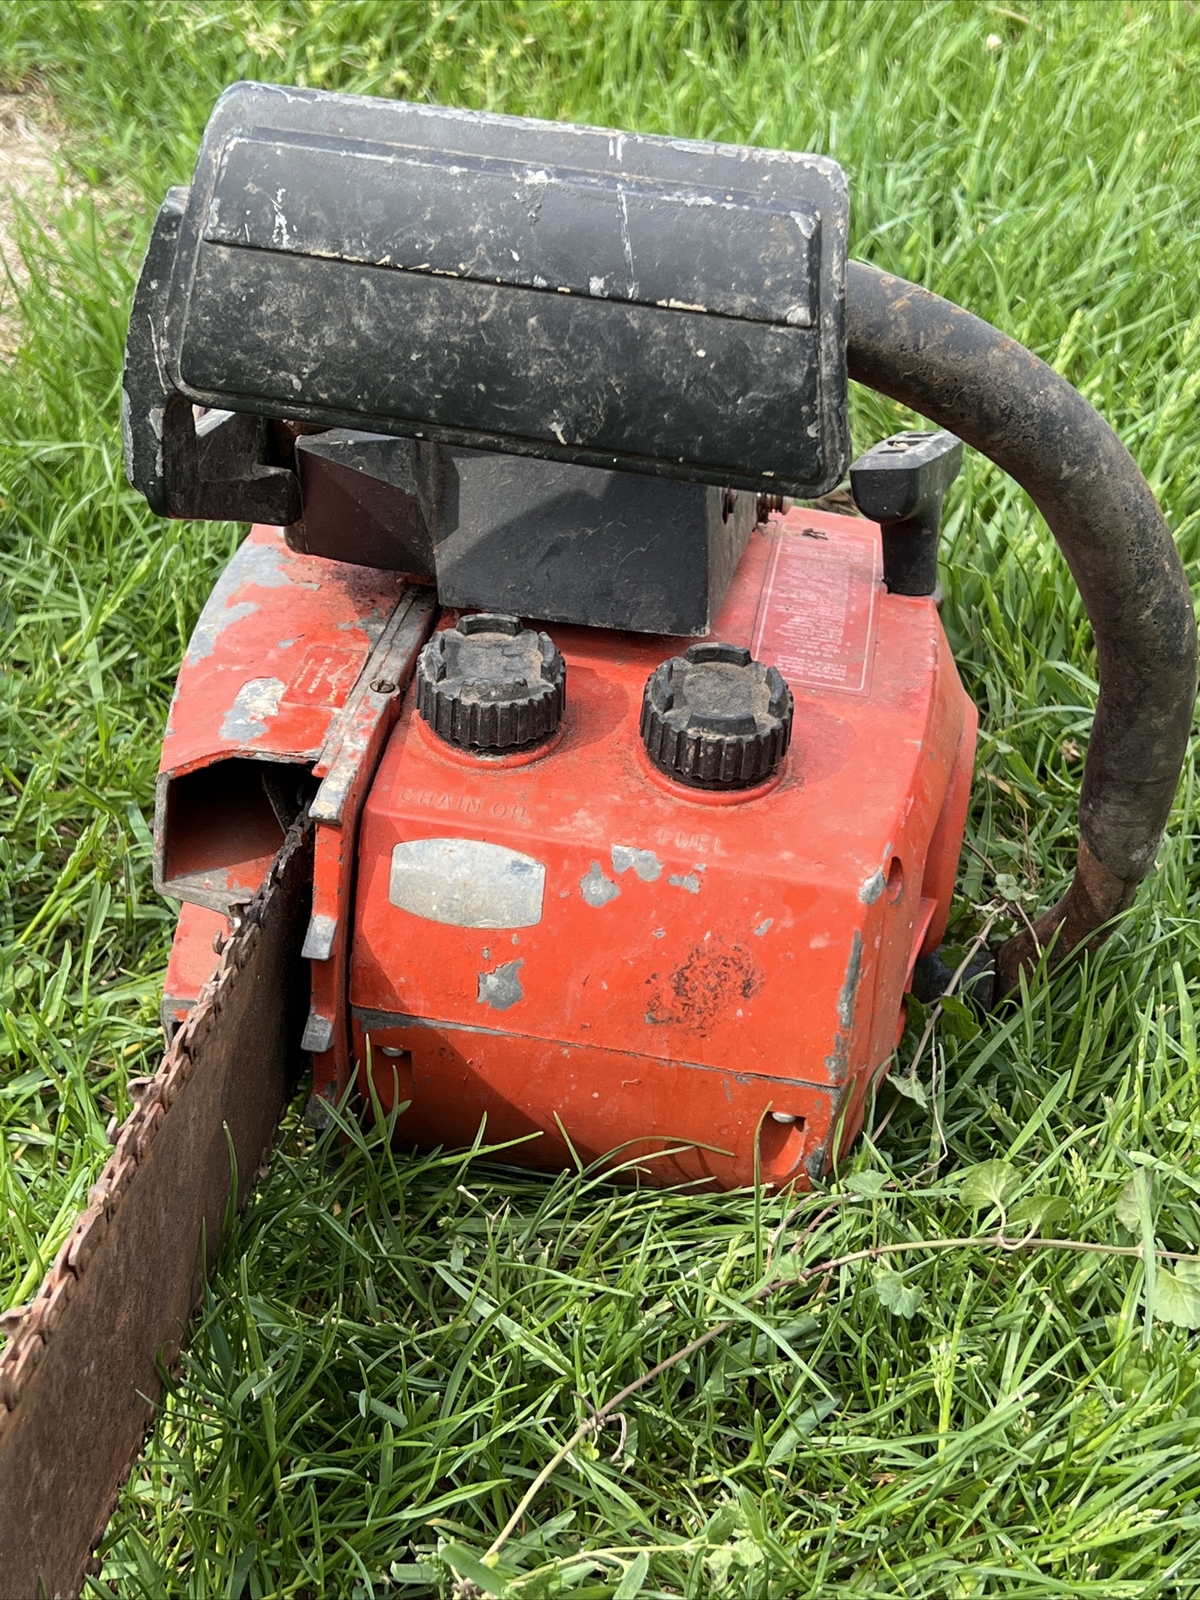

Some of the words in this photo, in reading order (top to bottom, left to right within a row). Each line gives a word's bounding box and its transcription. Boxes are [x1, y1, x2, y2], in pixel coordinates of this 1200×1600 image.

[401, 788, 482, 814] CHAIN
[492, 802, 532, 823] OIL
[657, 829, 728, 857] FUEL
